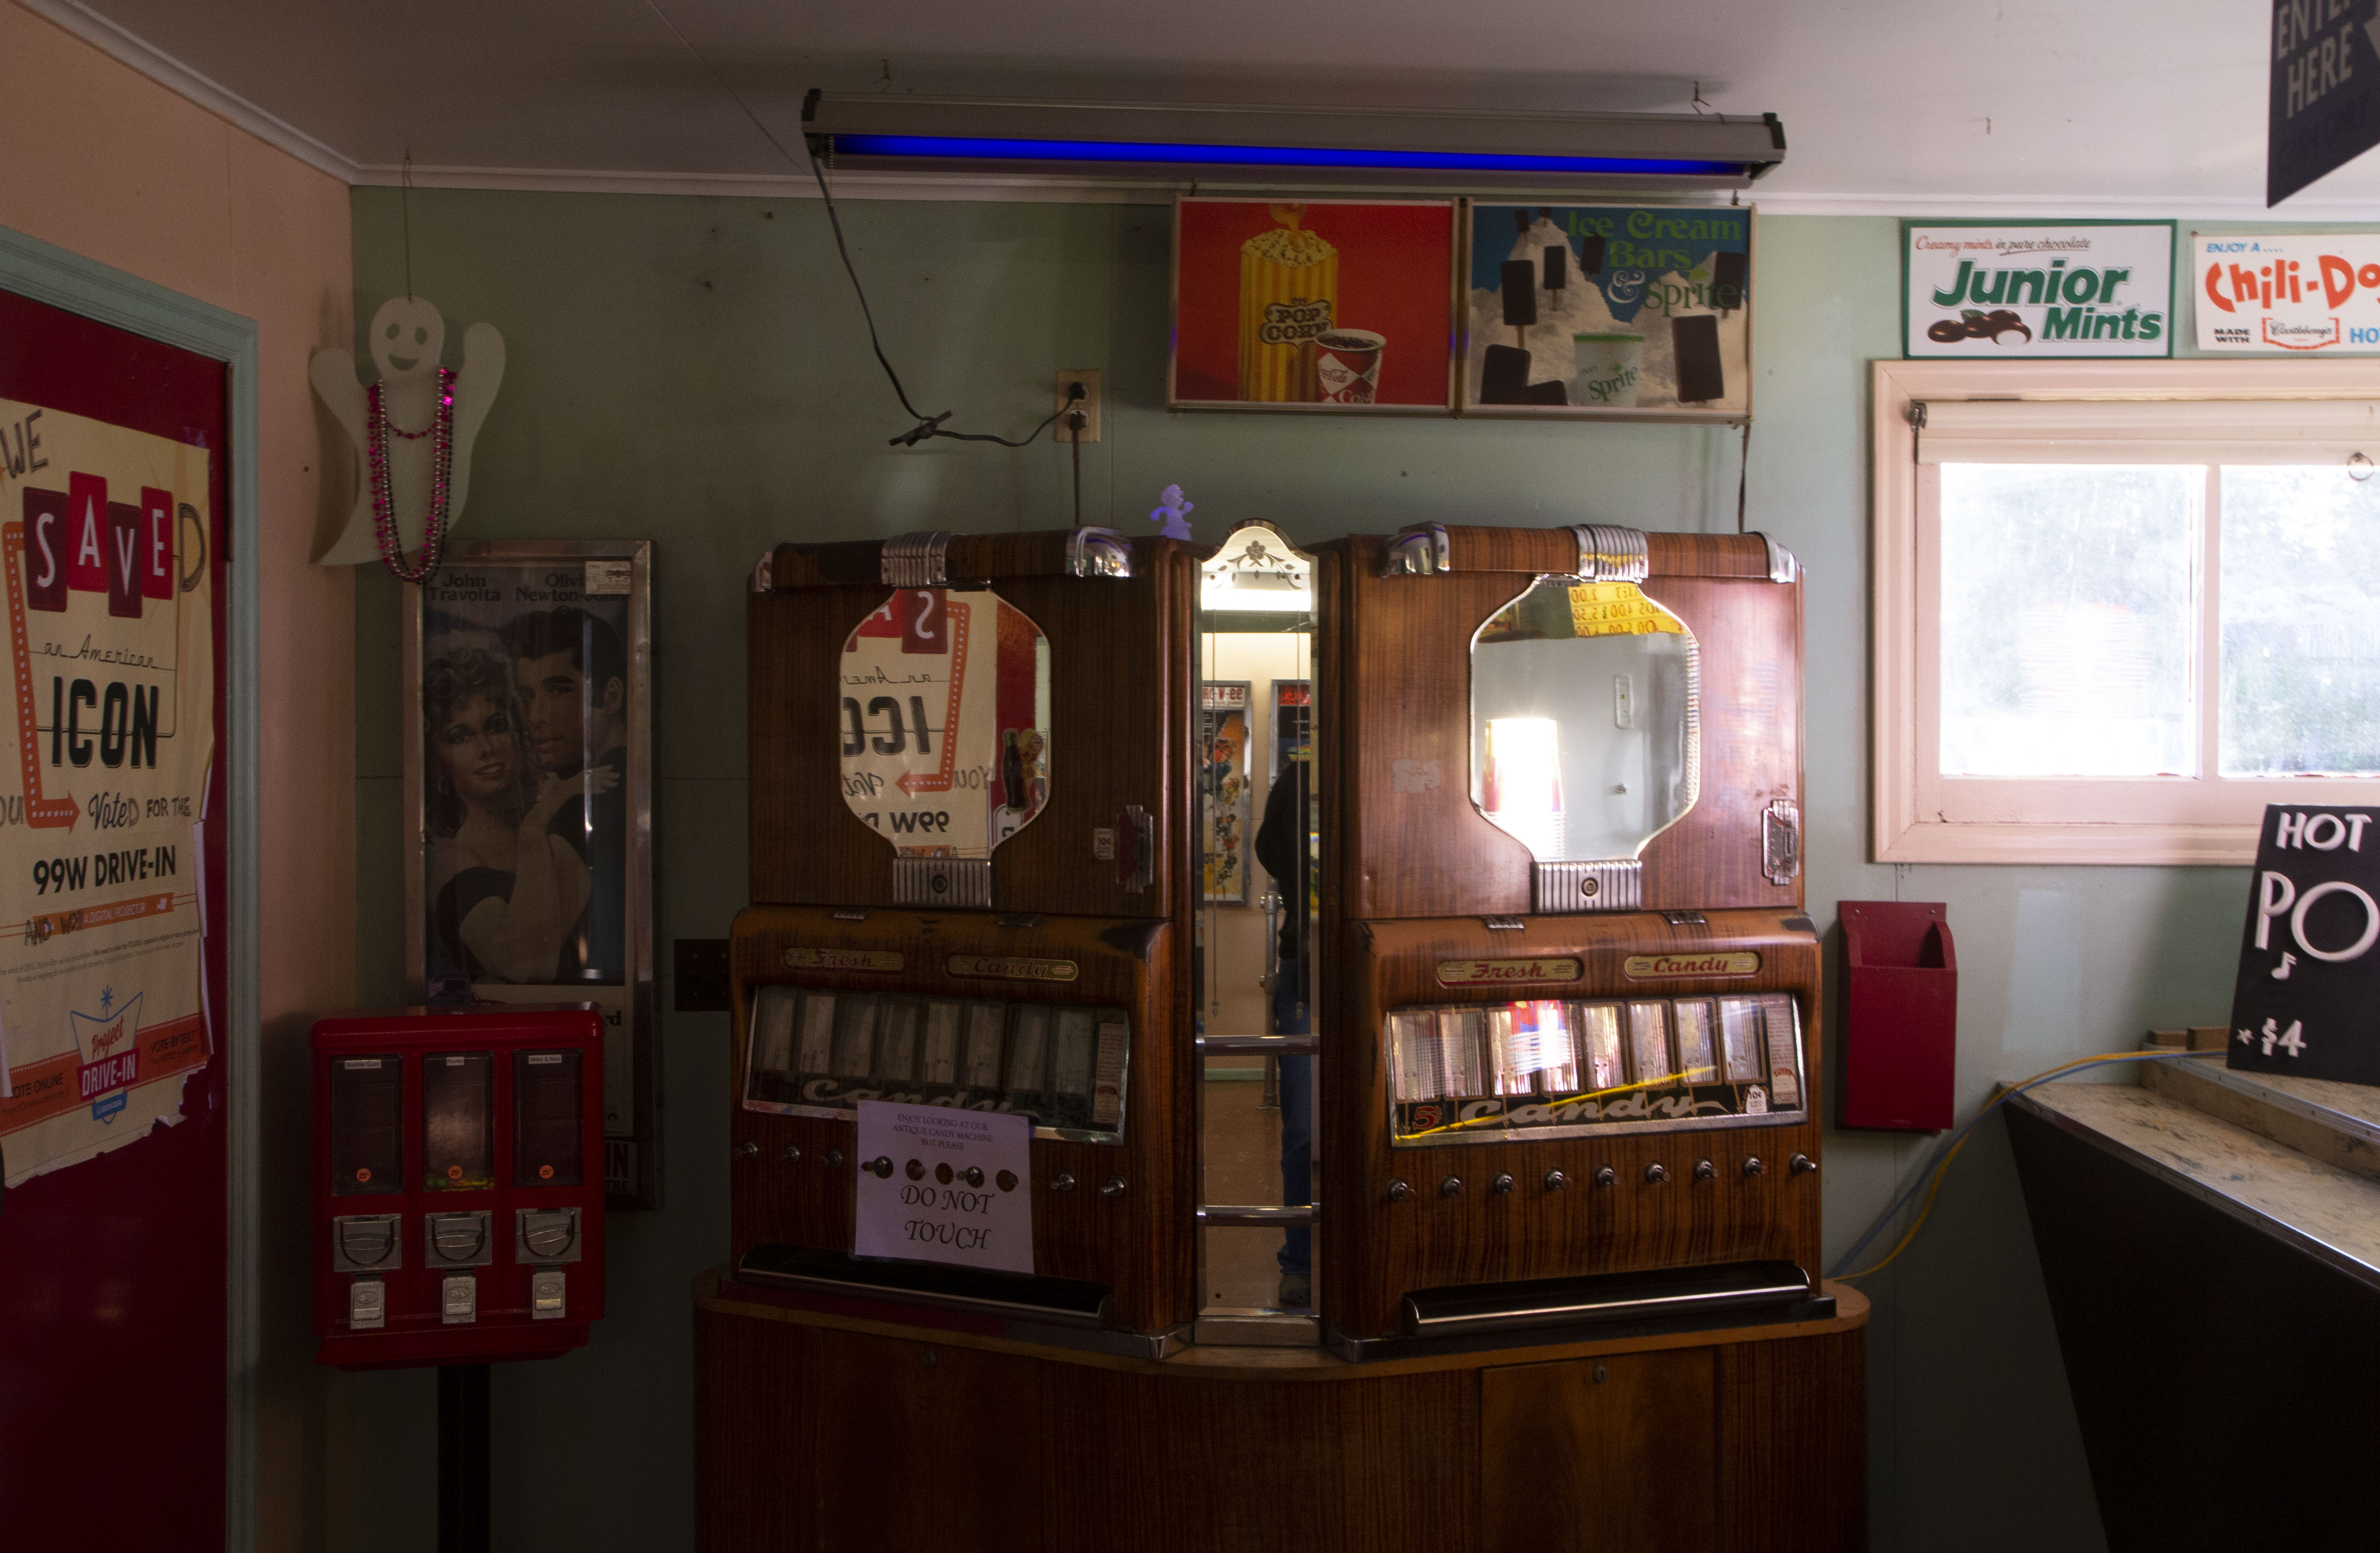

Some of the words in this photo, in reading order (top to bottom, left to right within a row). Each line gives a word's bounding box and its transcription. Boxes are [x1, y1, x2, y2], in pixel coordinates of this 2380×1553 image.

[2286, 21, 2354, 119] HERE
[1568, 211, 1614, 237] Ice
[1627, 210, 1740, 240] Cream
[1609, 241, 1691, 268] Bars
[1915, 235, 1961, 257] Creamy
[1962, 238, 1993, 250] mints
[1994, 240, 2006, 249] in
[2007, 240, 2035, 252] pure
[2036, 236, 2092, 250] chocolate
[2206, 242, 2248, 253] ENJOY
[1607, 270, 1645, 304] &
[1644, 280, 1740, 318] Sprite
[1931, 257, 2132, 308] Junior
[2204, 254, 2380, 313] Chili-Do
[1277, 308, 1320, 323] POP
[2038, 304, 2164, 342] Mints
[1266, 323, 1328, 340] CORN
[2349, 327, 2380, 344] HO
[1588, 367, 1638, 401] Sprite
[0, 409, 50, 479] WE
[36, 494, 207, 597] SAVED
[428, 587, 501, 602] Travolta
[443, 574, 486, 587] John
[545, 573, 585, 588] Olivi
[44, 642, 62, 656] an
[73, 633, 157, 669] American
[52, 676, 159, 769] ICON
[146, 796, 169, 818] FOR
[171, 796, 191, 817] THE
[2275, 811, 2372, 853] HOT
[33, 855, 88, 895] 99W
[95, 845, 177, 887] DRIVE-IN
[89, 909, 113, 923] DIGITAL
[115, 902, 146, 917] PROJECTOR
[811, 951, 876, 967] Fresh
[974, 958, 1049, 978] Candy
[1471, 963, 1547, 979] Fresh
[1652, 957, 1728, 974] Candy
[91, 1015, 124, 1060] Project
[150, 1038, 169, 1053] VOTE
[179, 1030, 196, 1044] TEXT
[2261, 1018, 2307, 1058] $4
[34, 1072, 63, 1092] ONLINE
[82, 1054, 136, 1096] DRIVE-IN
[898, 1114, 921, 1123] ENJOY
[922, 1116, 958, 1128] LOOKING
[970, 1122, 989, 1131] OUR
[1459, 1092, 1733, 1127] Candy
[893, 1125, 928, 1136] ANTIQUE
[929, 1128, 956, 1138] CANDY
[957, 1132, 993, 1143] MACHINE
[938, 1140, 965, 1151] PLEASE
[900, 1185, 937, 1207] DO
[940, 1190, 996, 1214] NOT
[904, 1219, 992, 1250] TOUCH
